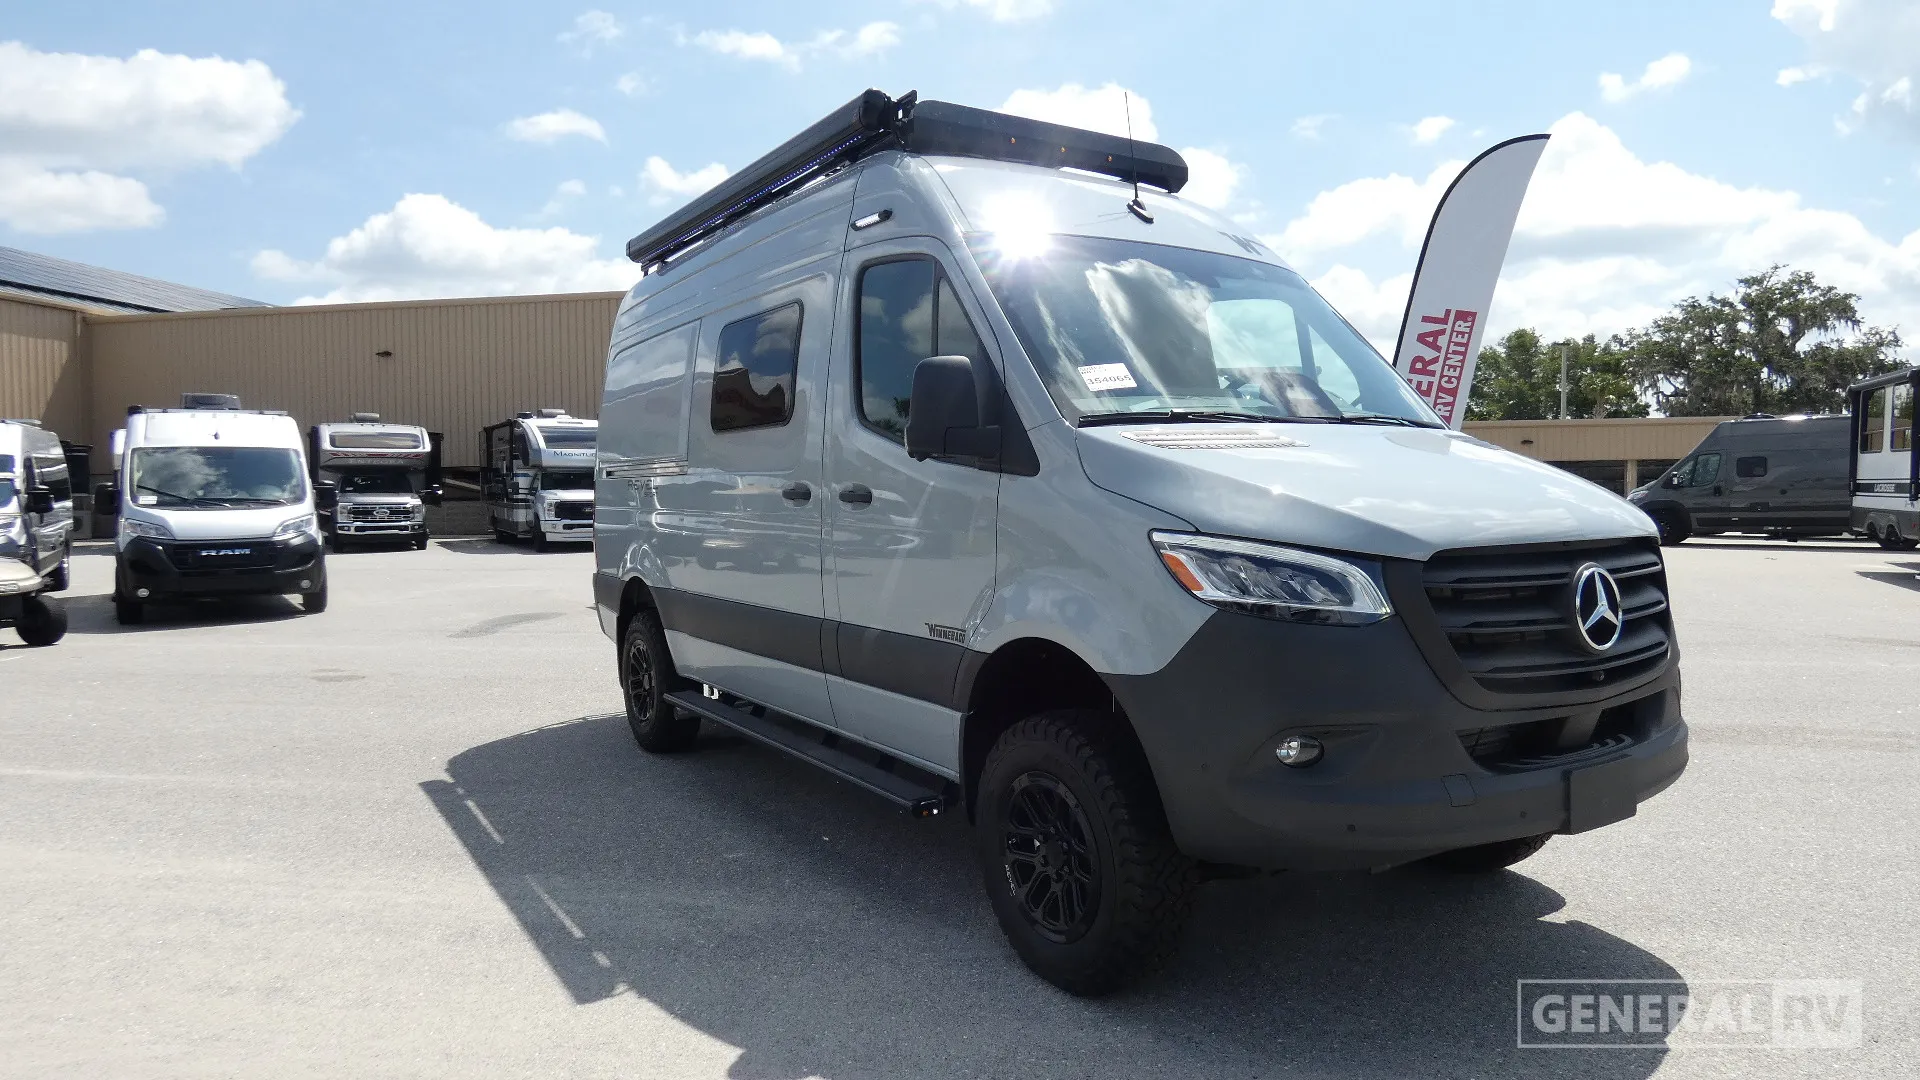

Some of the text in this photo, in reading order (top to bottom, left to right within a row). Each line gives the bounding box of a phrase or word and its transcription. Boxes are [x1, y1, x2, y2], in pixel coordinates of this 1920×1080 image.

[1434, 320, 1472, 417] RV CENTER
[200, 548, 251, 556] RAM
